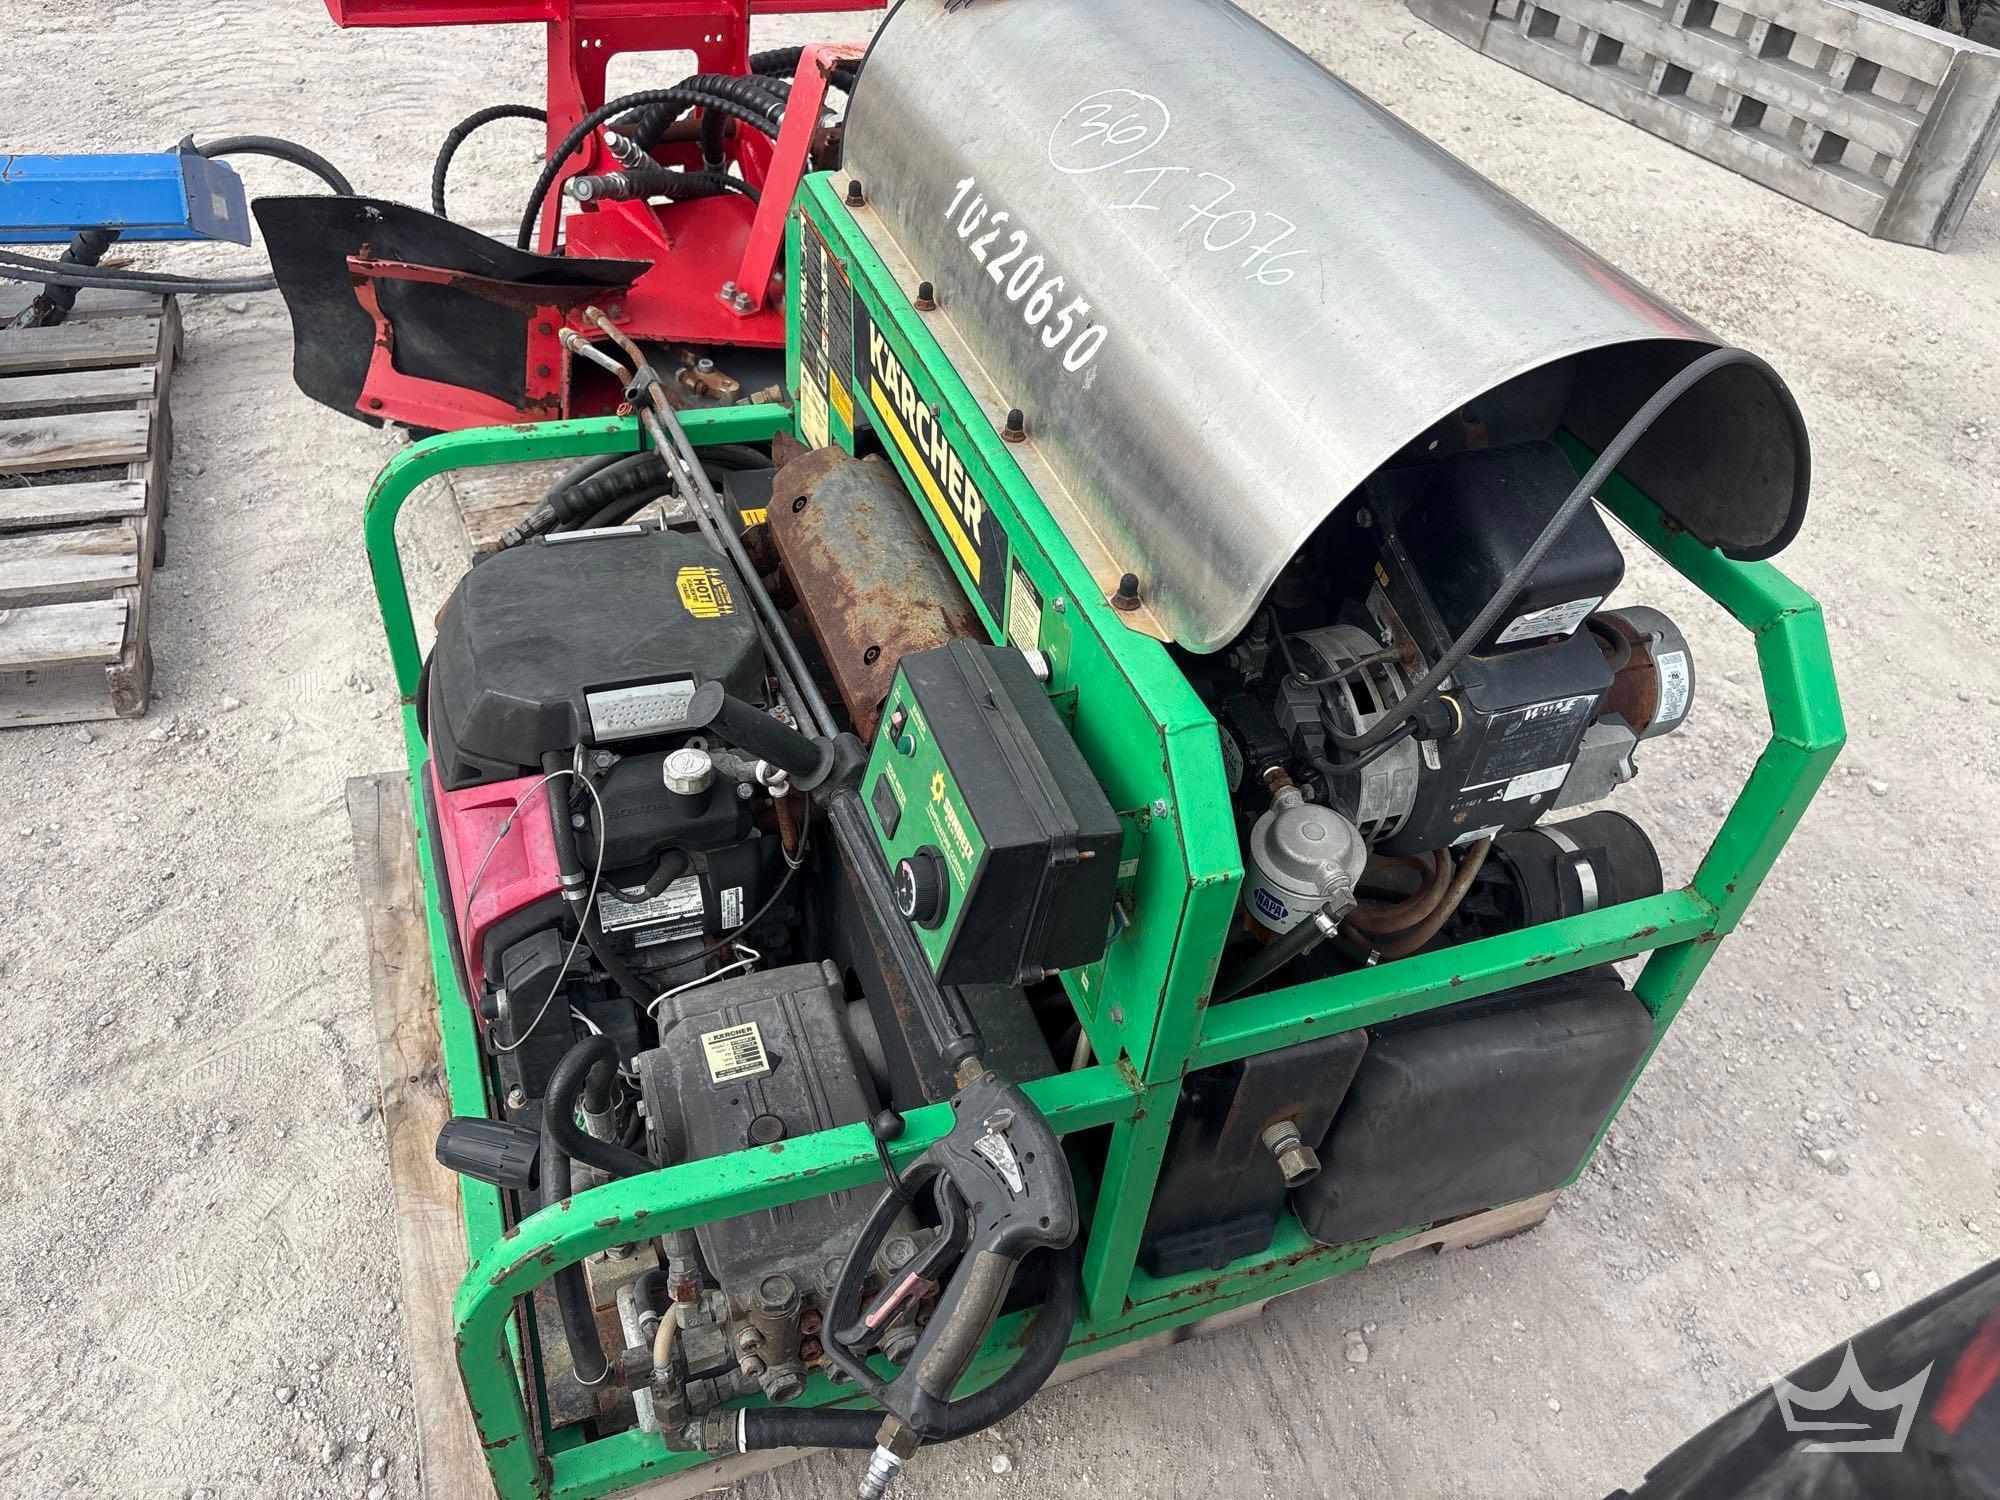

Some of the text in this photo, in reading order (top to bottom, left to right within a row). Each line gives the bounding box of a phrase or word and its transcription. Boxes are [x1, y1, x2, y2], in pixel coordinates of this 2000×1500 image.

[1070, 103, 1148, 147] 36
[944, 176, 1108, 373] 10220650
[869, 317, 982, 547] KÄRCHER
[693, 578, 713, 604] HOT!
[912, 704, 927, 735] BURNER
[886, 759, 907, 803] HOUR METER
[928, 799, 967, 887] TEMPERATURE CONTROL
[943, 796, 975, 858] SUNBELT
[944, 815, 966, 860] RENTALS
[1256, 890, 1284, 918] NAPA
